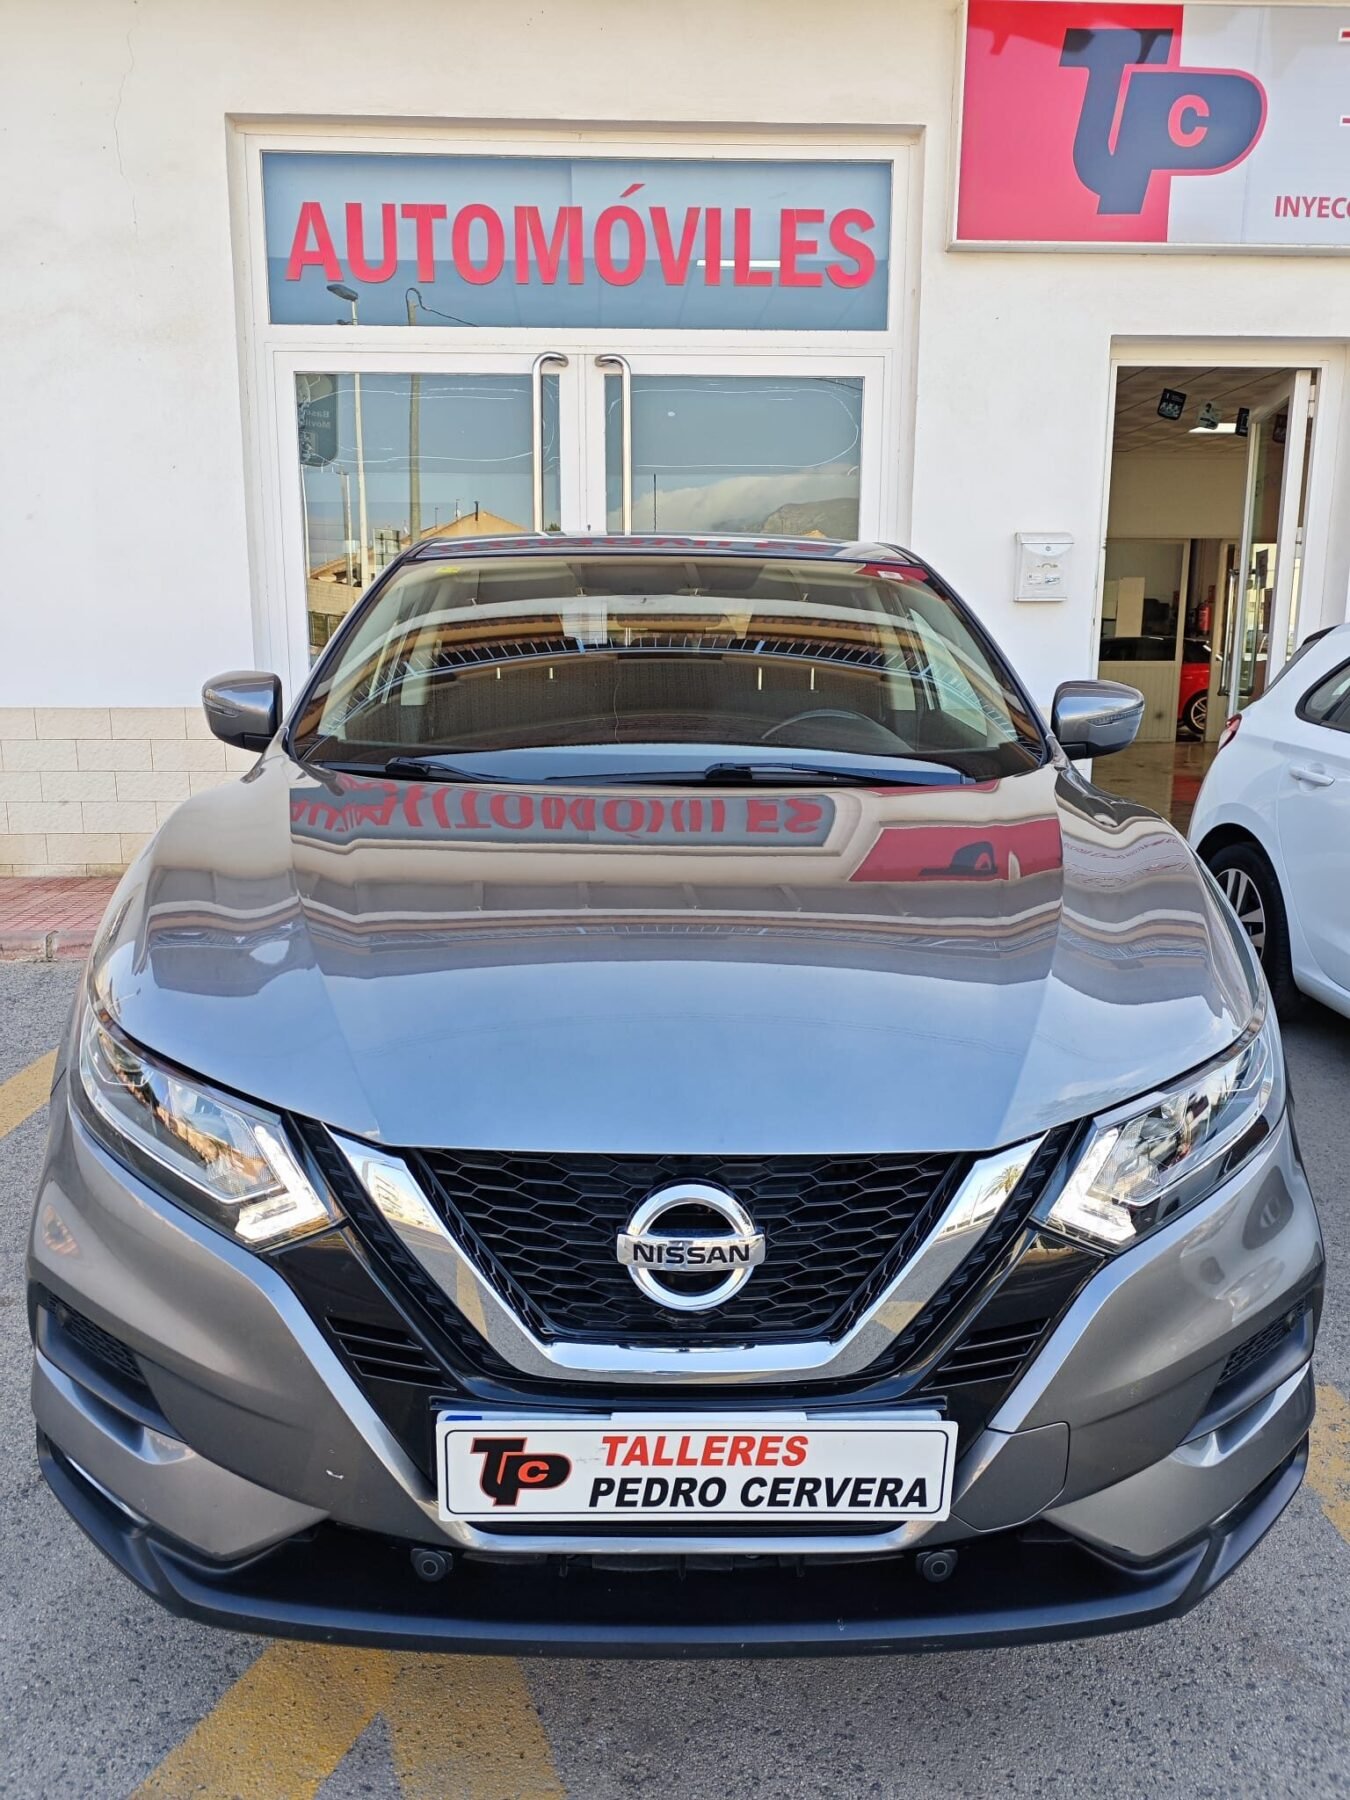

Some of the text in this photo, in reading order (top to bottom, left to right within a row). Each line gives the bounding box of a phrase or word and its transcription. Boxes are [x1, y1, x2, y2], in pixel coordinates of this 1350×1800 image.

[1274, 195, 1350, 219] INYEC
[285, 183, 876, 289] AUTOMÓVILES
[633, 1243, 750, 1265] NISSAN
[601, 1435, 809, 1467] TALLERES
[588, 1476, 928, 1509] PEDRO CERVERA
